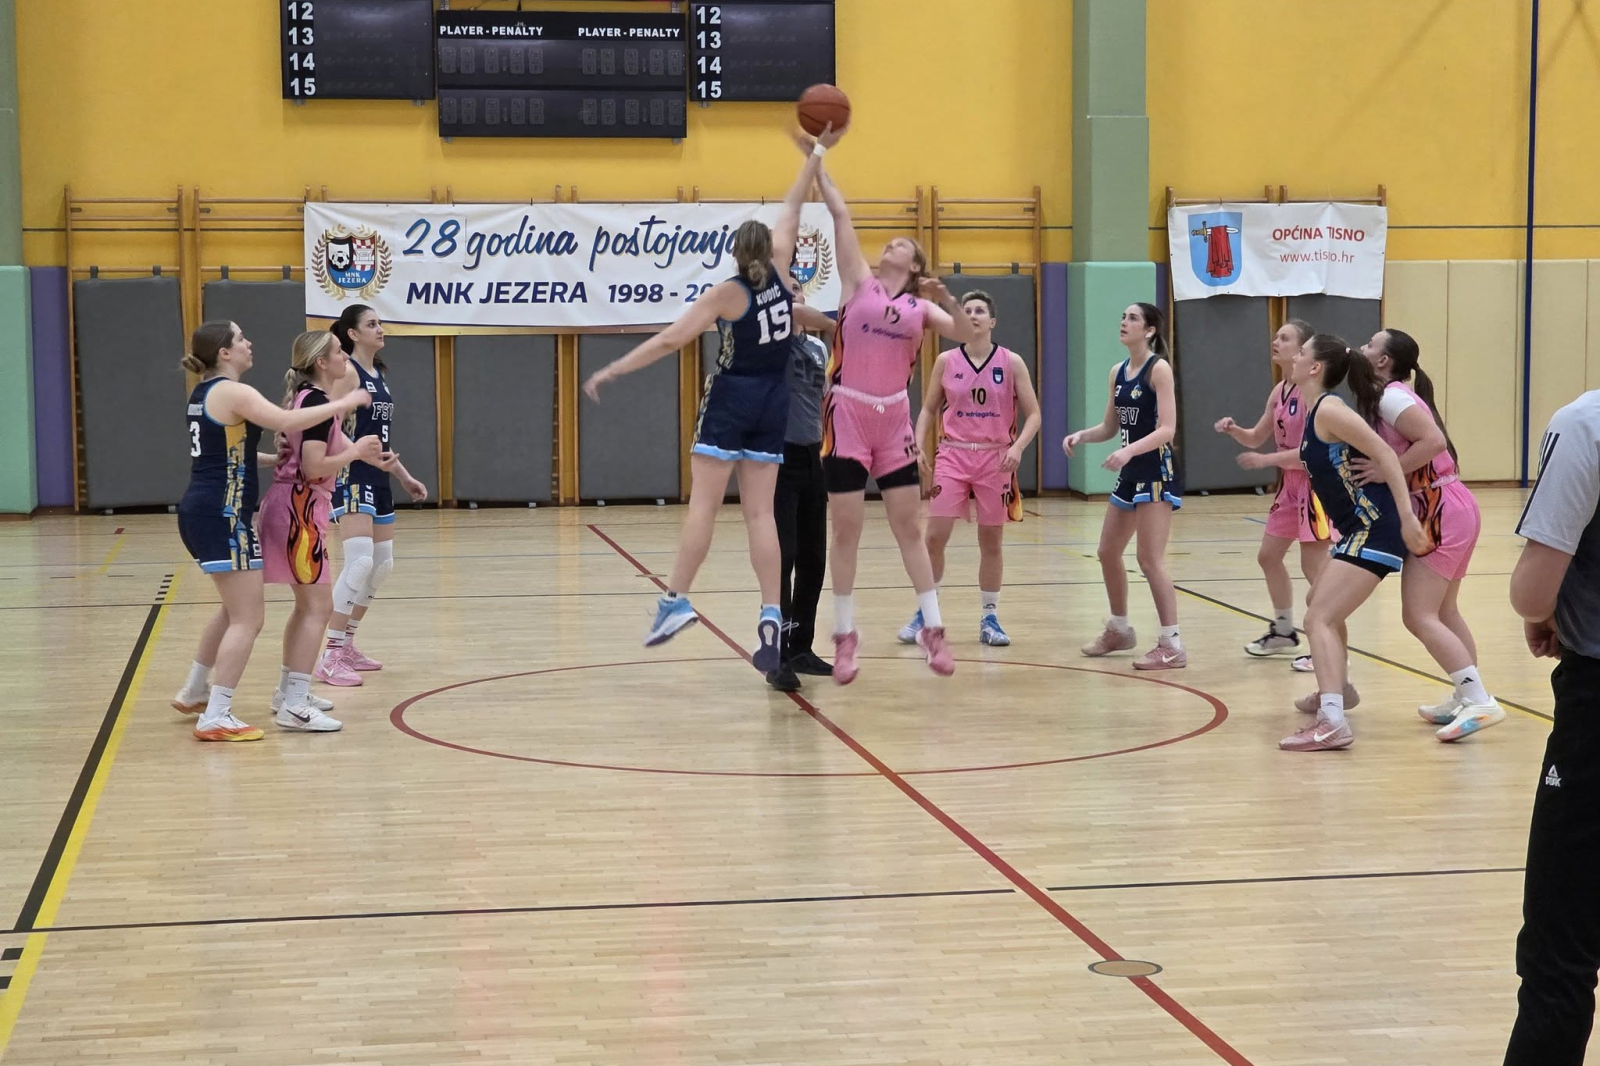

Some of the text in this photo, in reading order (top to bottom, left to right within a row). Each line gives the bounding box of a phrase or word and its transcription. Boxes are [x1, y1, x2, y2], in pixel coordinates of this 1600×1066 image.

[287, 1, 314, 20] 12
[696, 6, 722, 24] 12
[288, 26, 314, 46] 13
[696, 30, 722, 49] 13
[289, 52, 316, 71] 14
[697, 56, 722, 74] 14
[290, 77, 316, 96] 15
[697, 80, 722, 99] 15
[402, 218, 461, 258] 28
[462, 215, 579, 270] godina
[1272, 224, 1365, 242] OPĆINA TISNO
[406, 282, 475, 305] MNK
[479, 281, 588, 304] JEZERA
[608, 283, 664, 303] 1998
[755, 282, 782, 307] KUDIĆ
[757, 299, 791, 345] 15
[971, 387, 987, 406] 10
[189, 420, 202, 457] 3
[382, 424, 389, 443] 5
